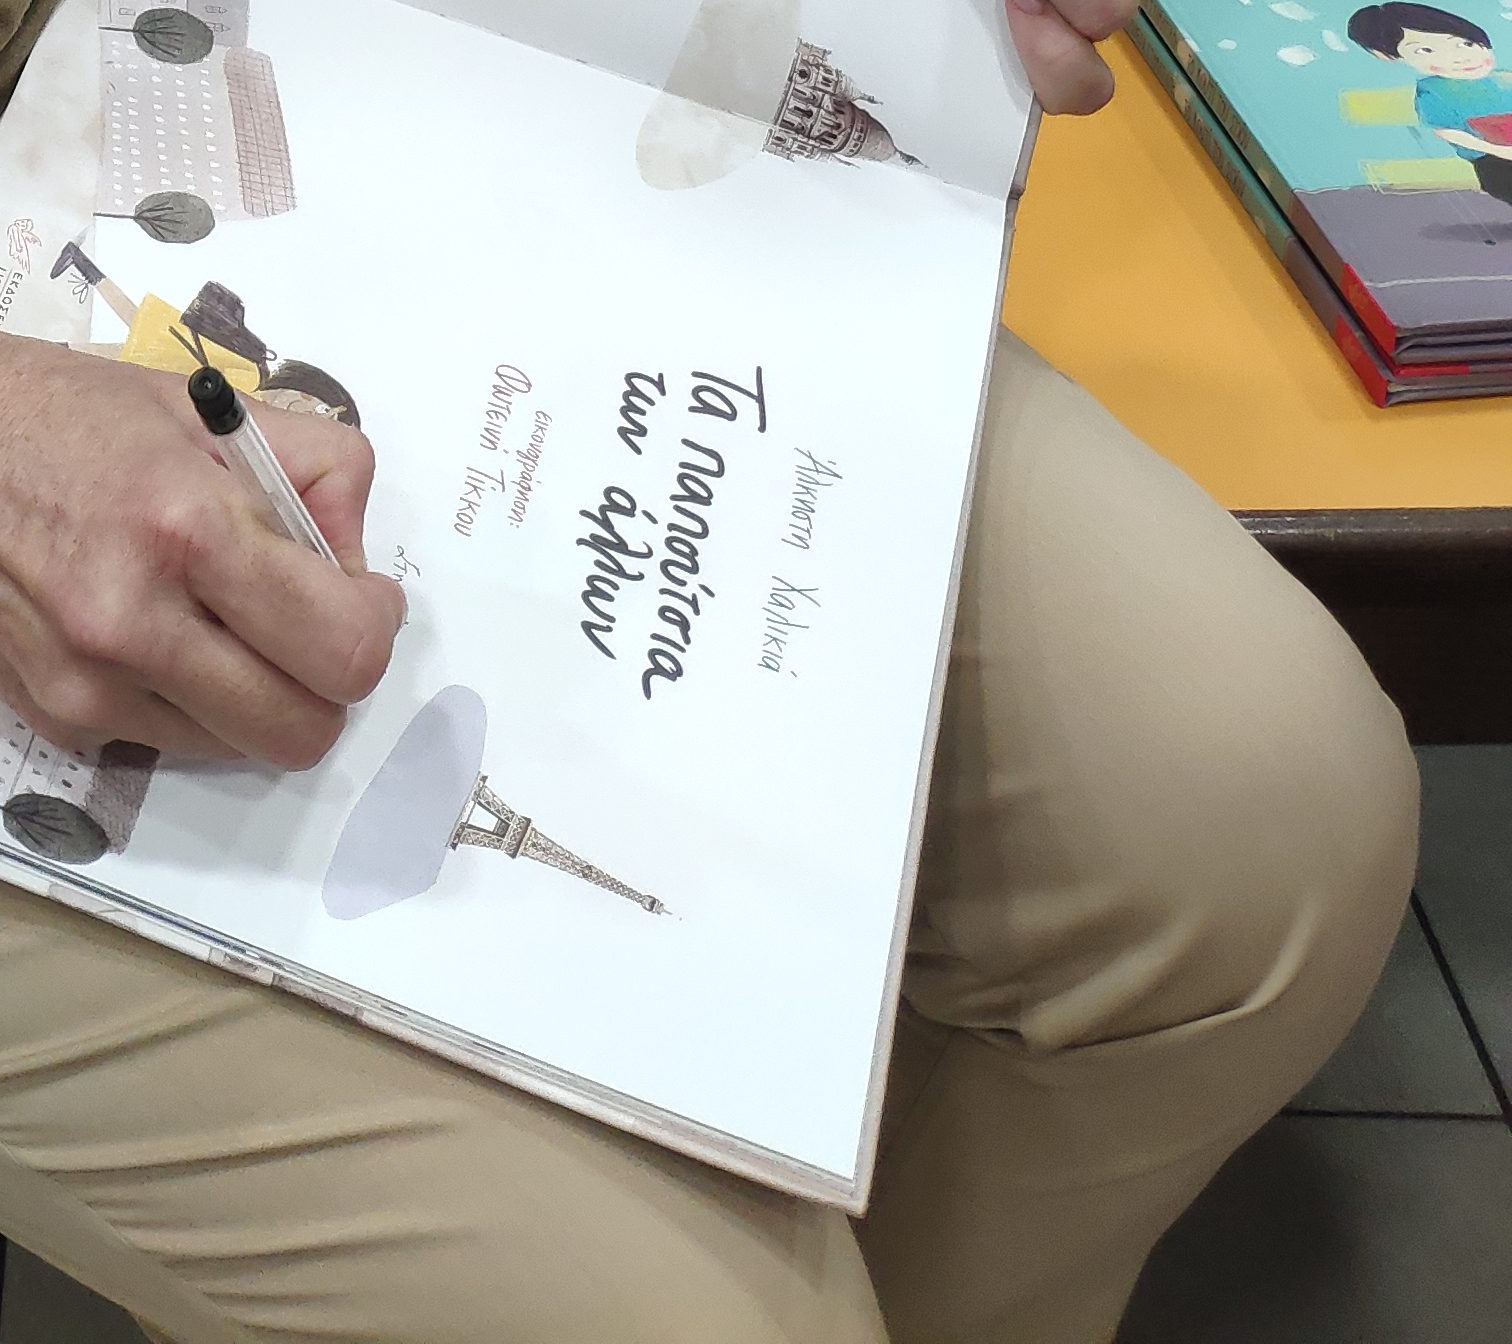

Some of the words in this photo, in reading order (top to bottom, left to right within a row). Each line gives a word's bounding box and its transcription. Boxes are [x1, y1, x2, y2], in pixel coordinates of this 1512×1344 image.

[479, 363, 532, 455] Φωτεινή
[617, 371, 667, 456] των
[688, 366, 766, 433] Τα
[453, 465, 505, 538] Τίκκου
[508, 410, 553, 530] εικονογράφηση:
[782, 447, 843, 550] Άλκηστη
[576, 485, 659, 660] άλλων
[641, 438, 726, 700] παπούτσια
[758, 575, 820, 678] Χαλικιά
